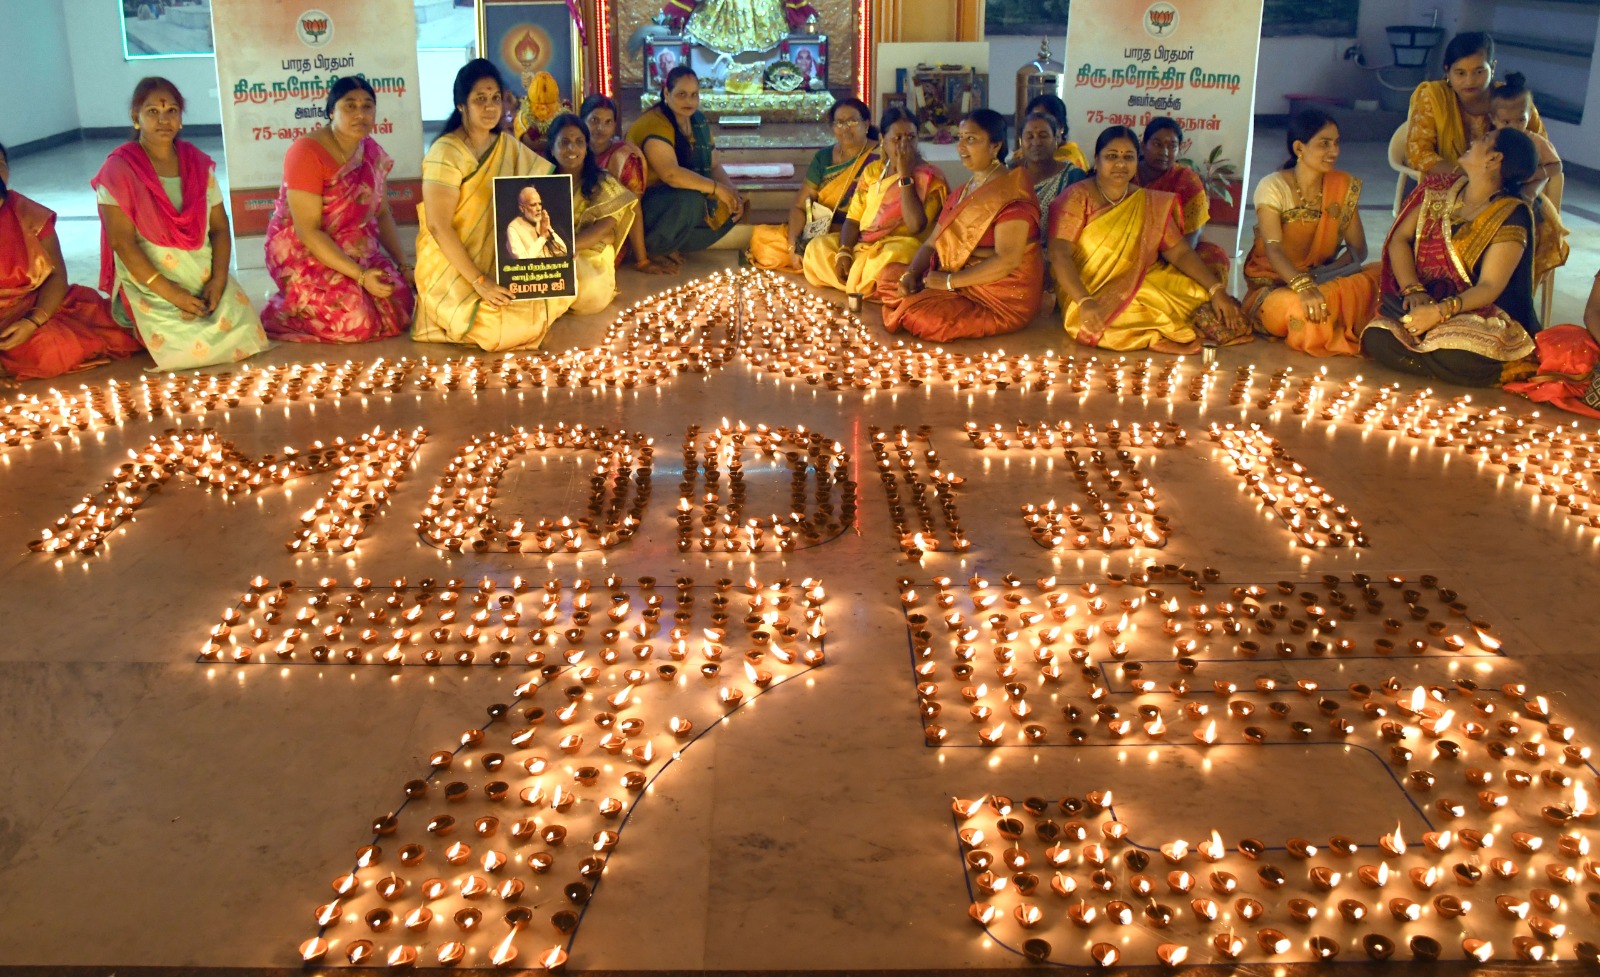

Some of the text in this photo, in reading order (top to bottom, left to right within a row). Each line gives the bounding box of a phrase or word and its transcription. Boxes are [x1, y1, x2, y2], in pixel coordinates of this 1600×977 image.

[282, 53, 355, 74] பாரத பிரதமர்
[1124, 45, 1194, 63] பாரத பிரதமர்
[1189, 67, 1241, 95] மோடி
[509, 282, 549, 294] மோடி
